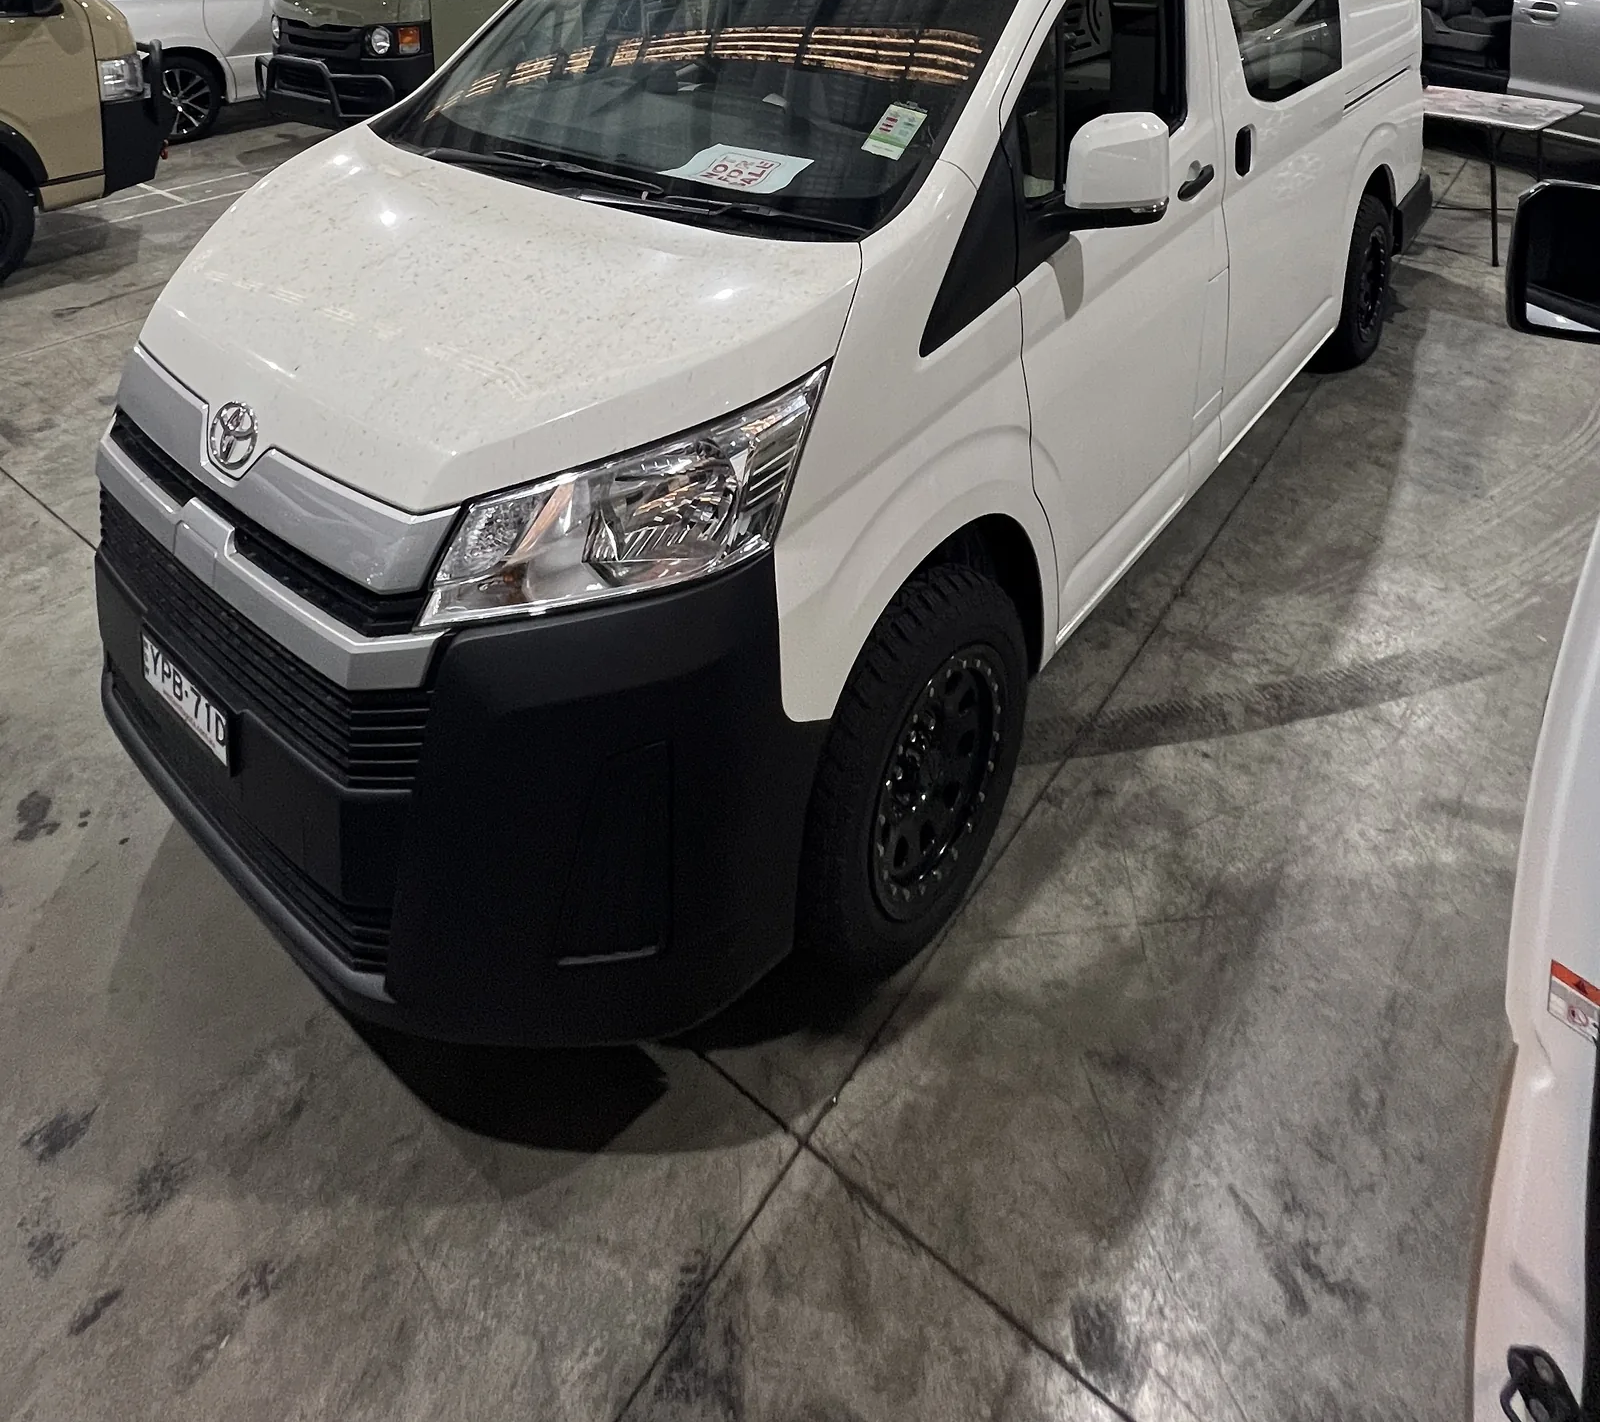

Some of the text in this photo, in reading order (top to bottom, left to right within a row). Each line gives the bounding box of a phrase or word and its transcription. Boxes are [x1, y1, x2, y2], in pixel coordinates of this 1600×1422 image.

[700, 156, 736, 178] NOT
[718, 160, 755, 182] FOR
[728, 161, 775, 186] SALE
